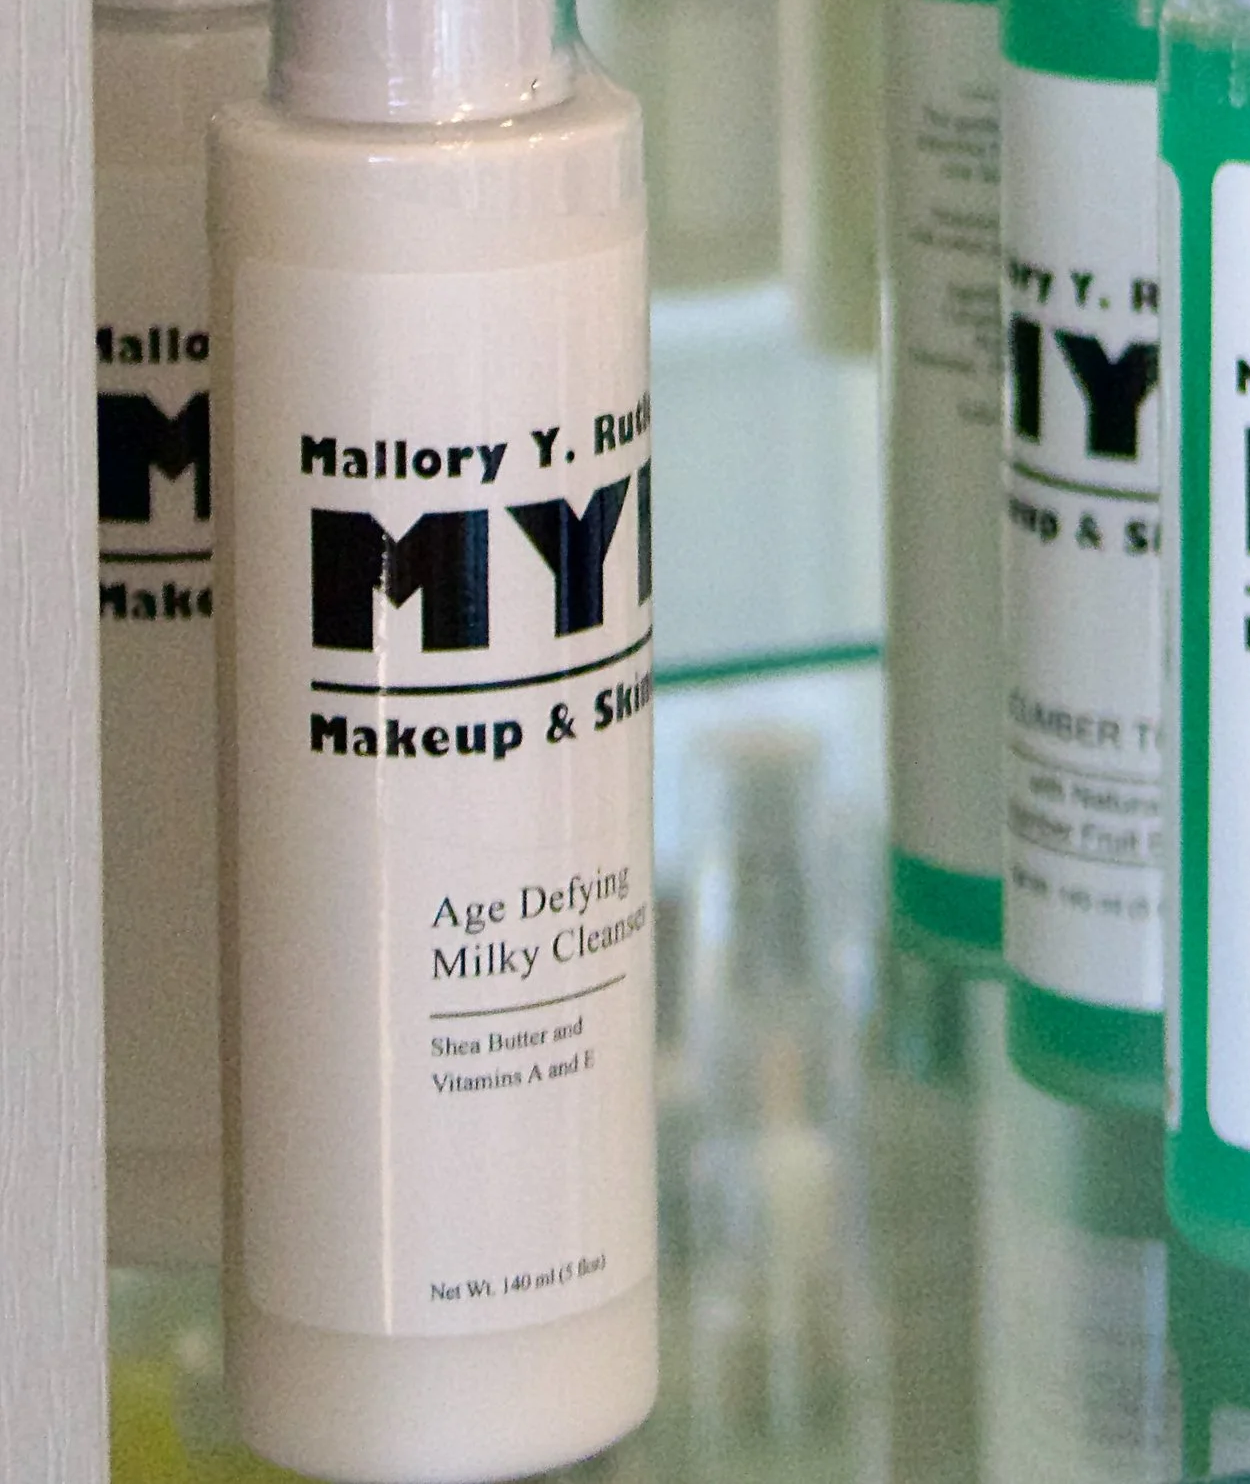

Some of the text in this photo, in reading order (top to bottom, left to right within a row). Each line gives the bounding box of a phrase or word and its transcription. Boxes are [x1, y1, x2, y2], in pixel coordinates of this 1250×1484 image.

[97, 391, 211, 524] M
[300, 426, 576, 484] Mallory Y.
[309, 702, 576, 761] Makeup &
[432, 864, 629, 935] Age Defying
[432, 943, 539, 981] Milky
[430, 1016, 584, 1058] Shea Butter and
[432, 1067, 523, 1094] Vitamins
[527, 1064, 544, 1084] A
[548, 1053, 579, 1080] and
[430, 1282, 462, 1303] Net
